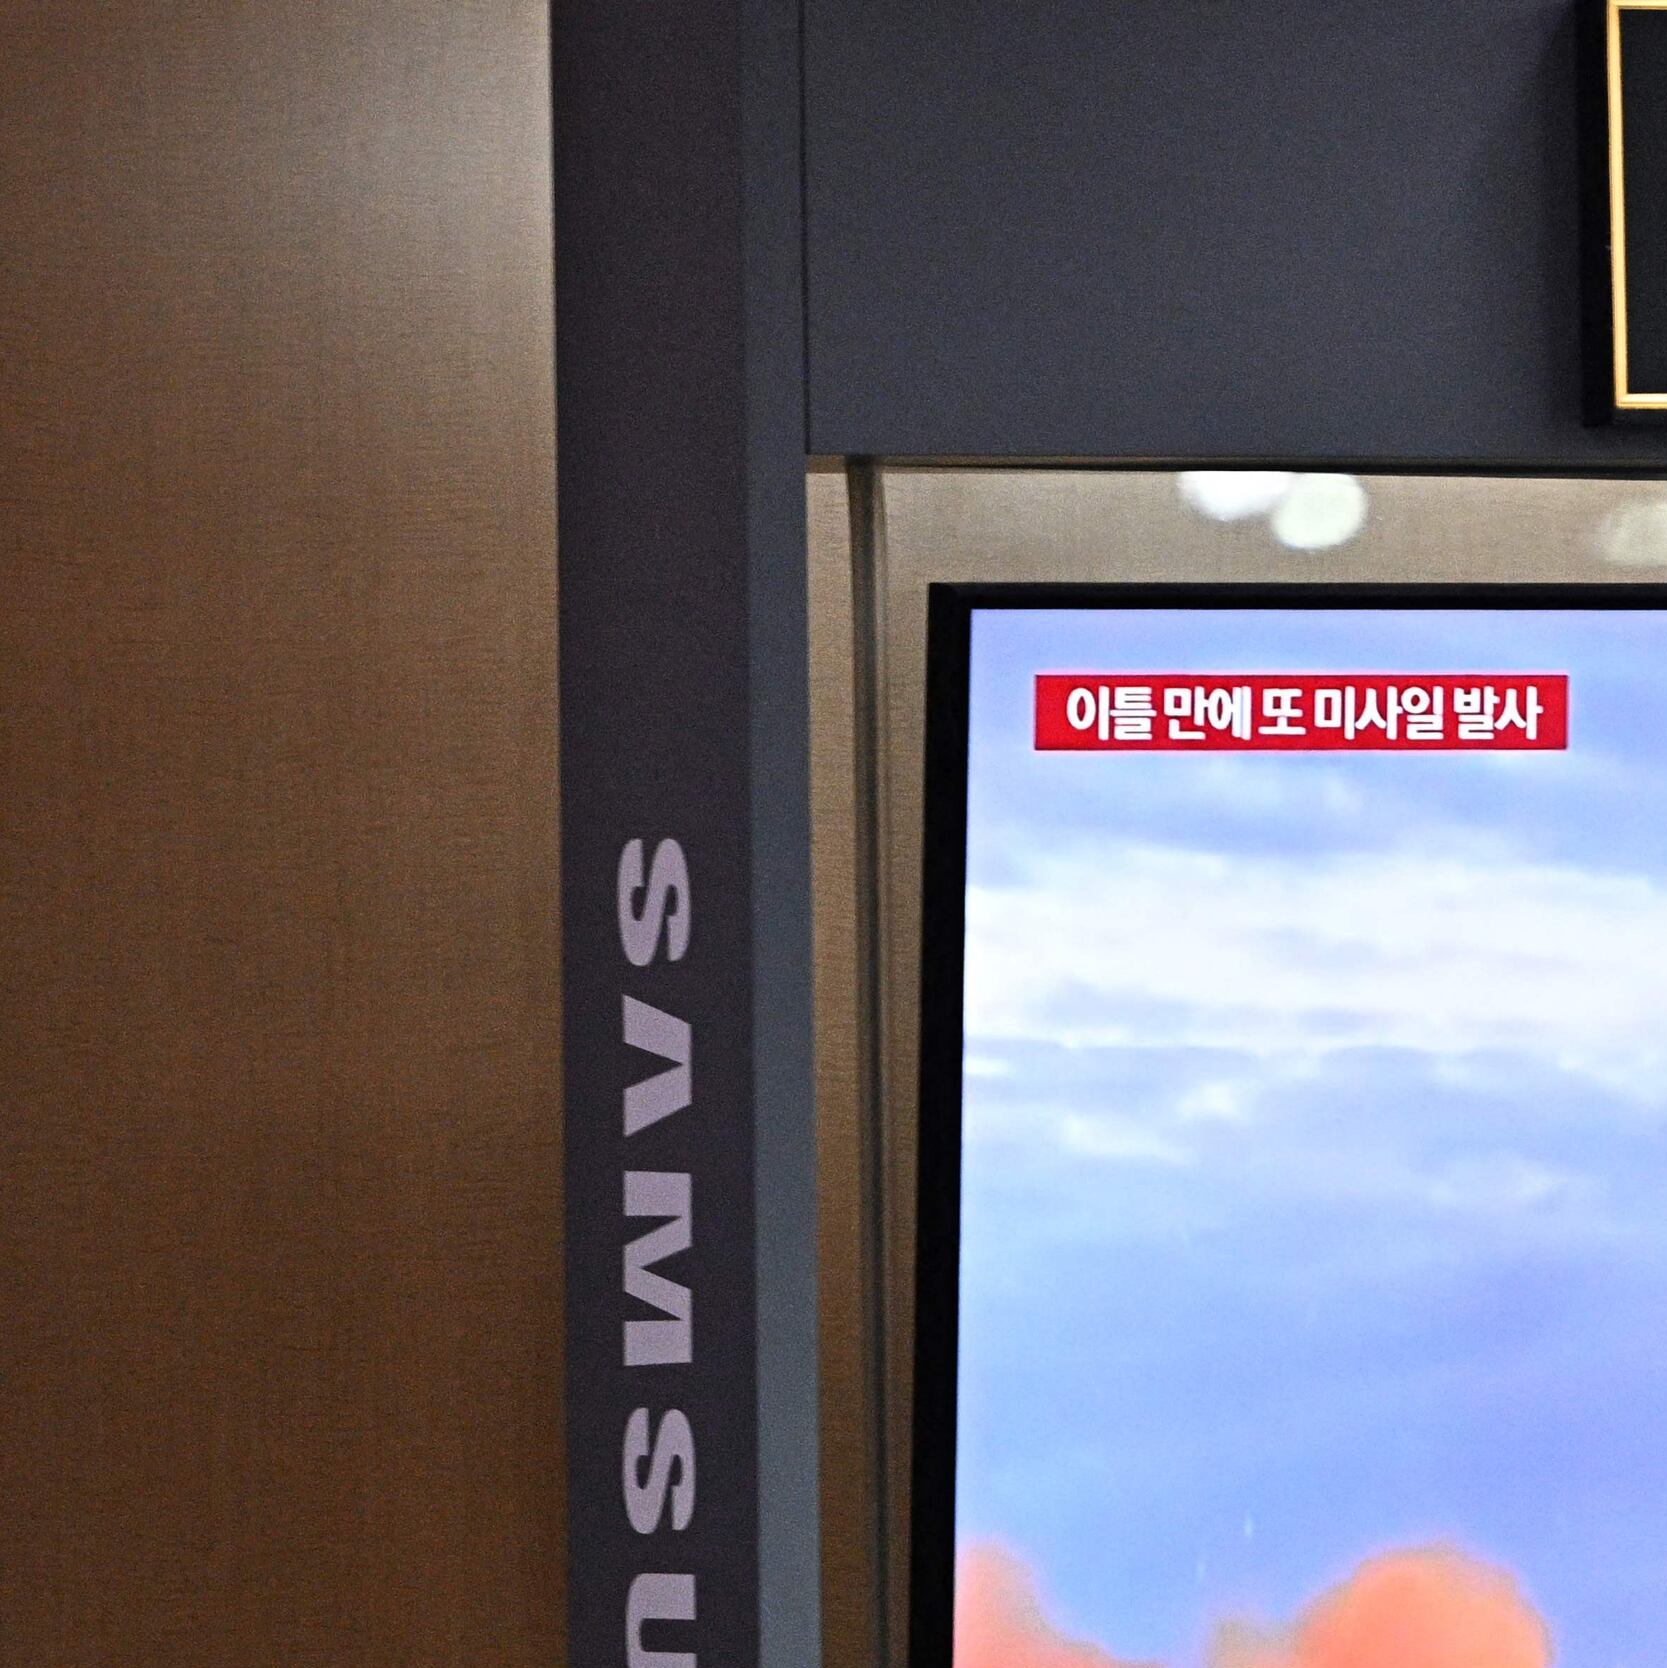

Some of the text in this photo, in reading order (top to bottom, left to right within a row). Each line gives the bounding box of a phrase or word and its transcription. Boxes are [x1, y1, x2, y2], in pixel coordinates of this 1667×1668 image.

[1066, 685, 1544, 741] 이틀 만에 또 미사일 발사
